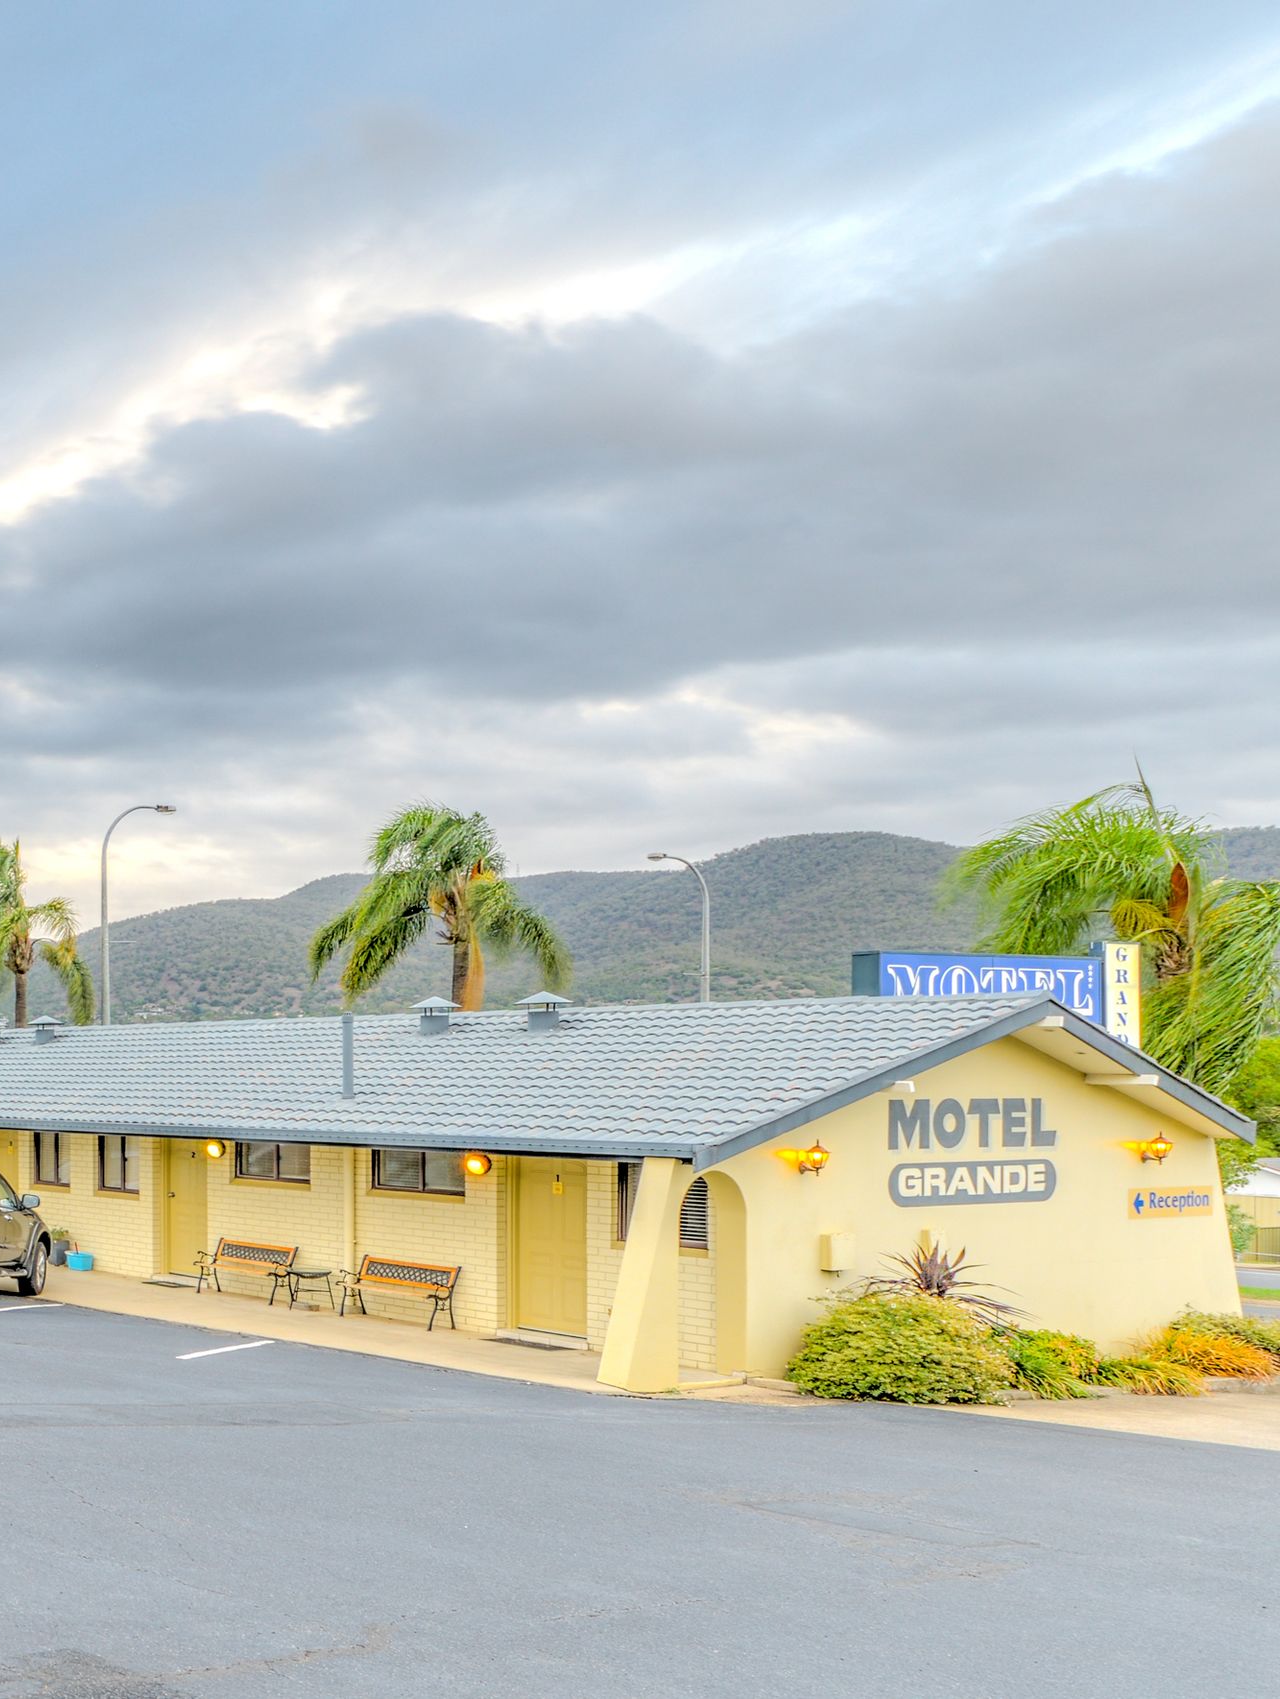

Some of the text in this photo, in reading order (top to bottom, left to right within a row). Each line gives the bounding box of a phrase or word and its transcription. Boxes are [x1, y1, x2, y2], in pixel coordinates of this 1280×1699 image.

[887, 1098, 1057, 1150] MOTEL
[898, 1163, 1046, 1197] GRANDE
[1149, 1190, 1209, 1212] Reception
